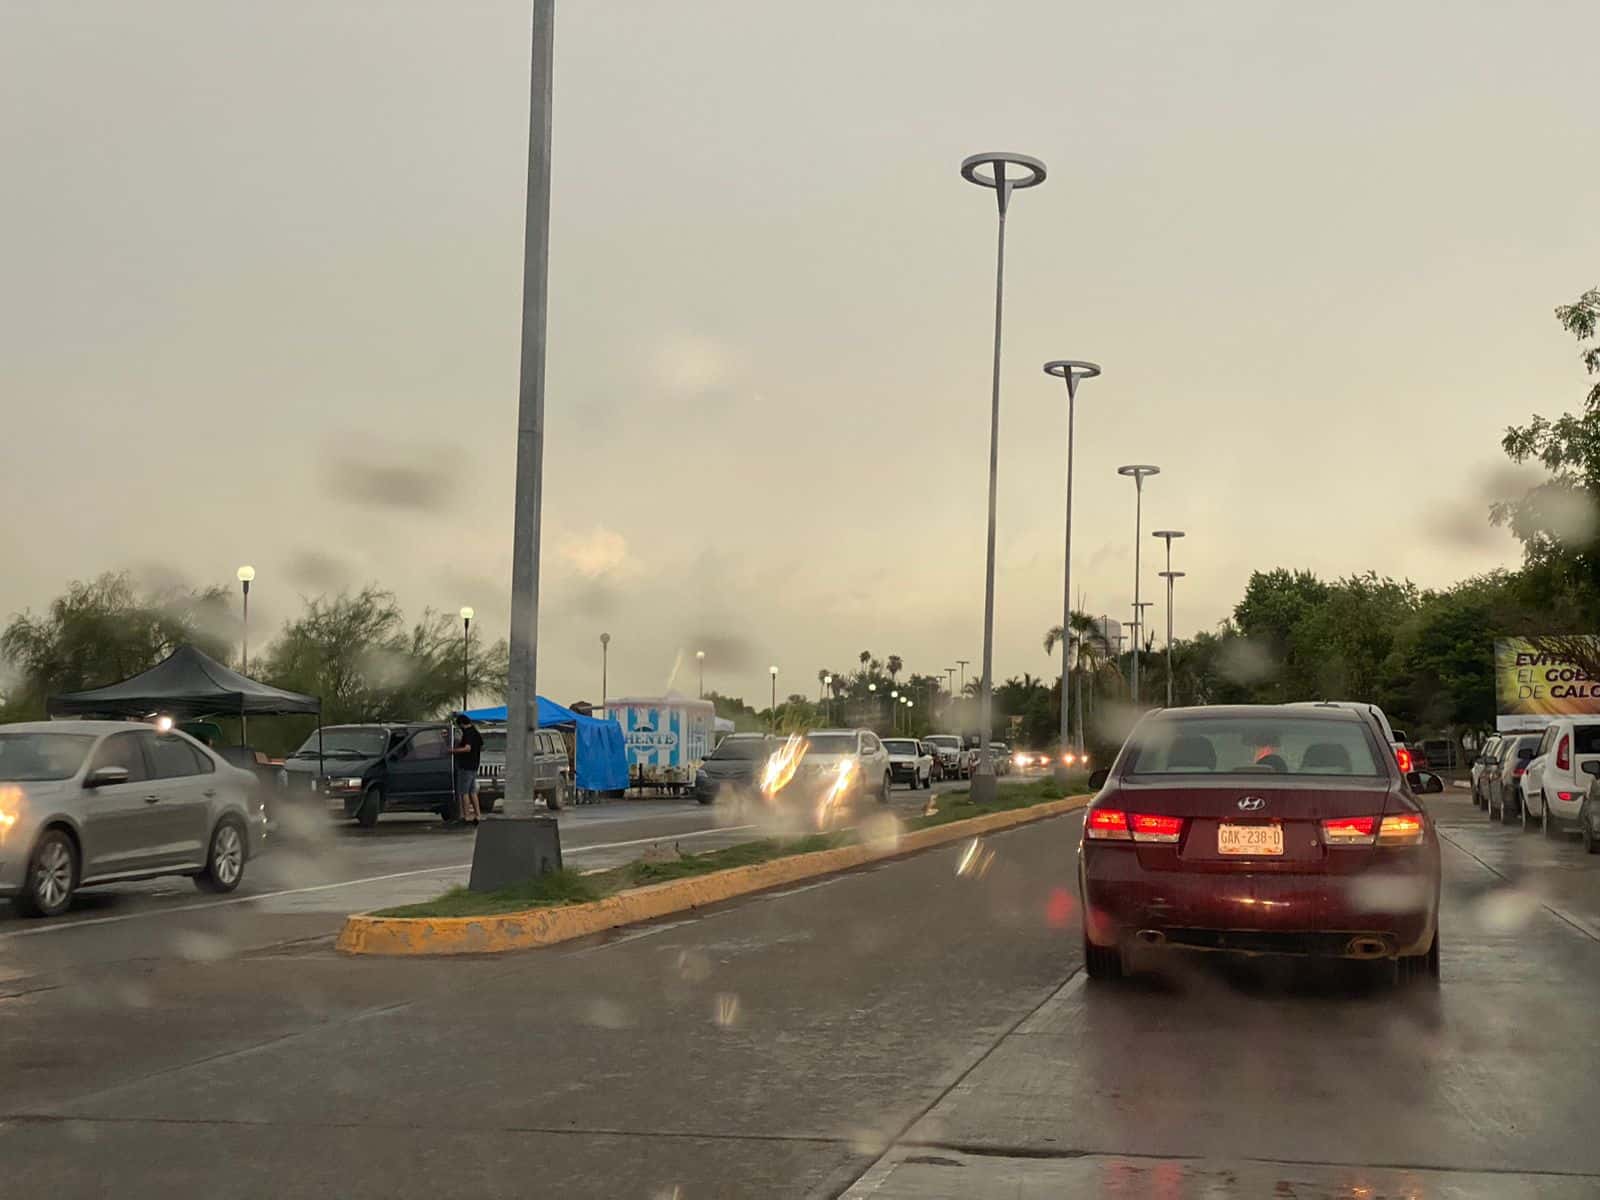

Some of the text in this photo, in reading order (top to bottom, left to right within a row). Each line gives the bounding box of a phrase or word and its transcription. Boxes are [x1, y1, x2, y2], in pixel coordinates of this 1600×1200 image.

[1518, 668, 1540, 683] EL
[1519, 685, 1545, 699] DE
[625, 733, 674, 745] HENTE
[1220, 829, 1280, 845] GAK-238-D
